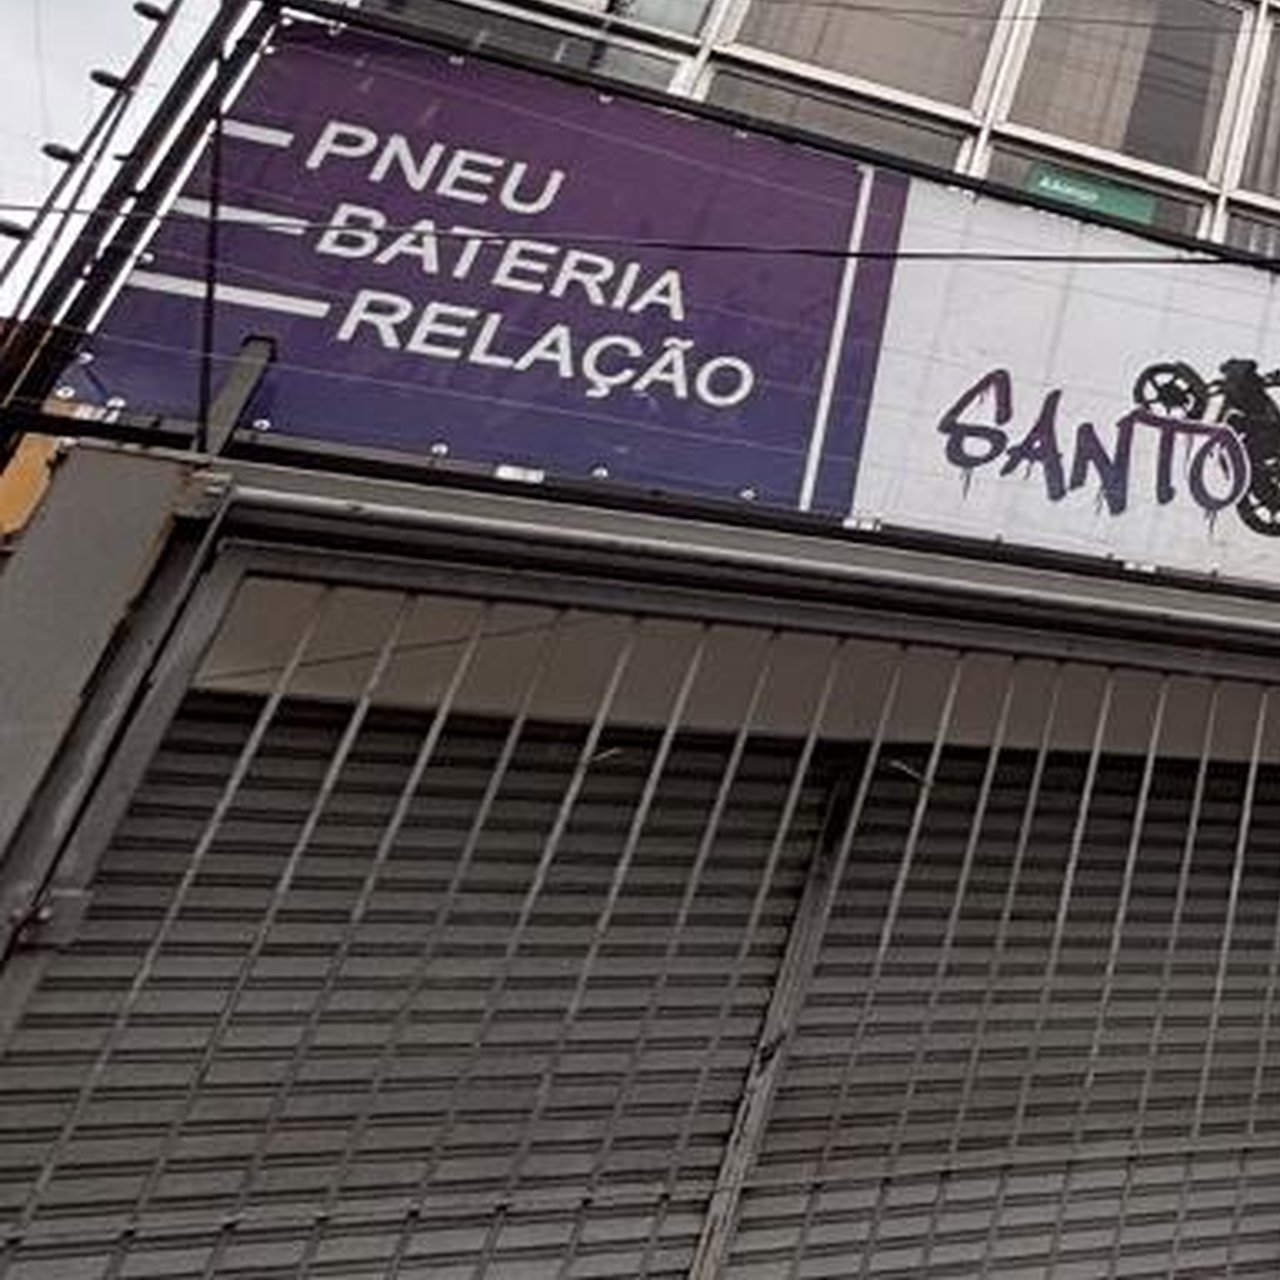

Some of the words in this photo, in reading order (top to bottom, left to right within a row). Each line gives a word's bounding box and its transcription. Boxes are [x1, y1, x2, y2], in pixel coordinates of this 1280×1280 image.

[306, 121, 565, 214] PNEU
[315, 203, 686, 320] BATERIA
[337, 289, 755, 407] RELAÇÃO
[937, 368, 1250, 517] SANTO
